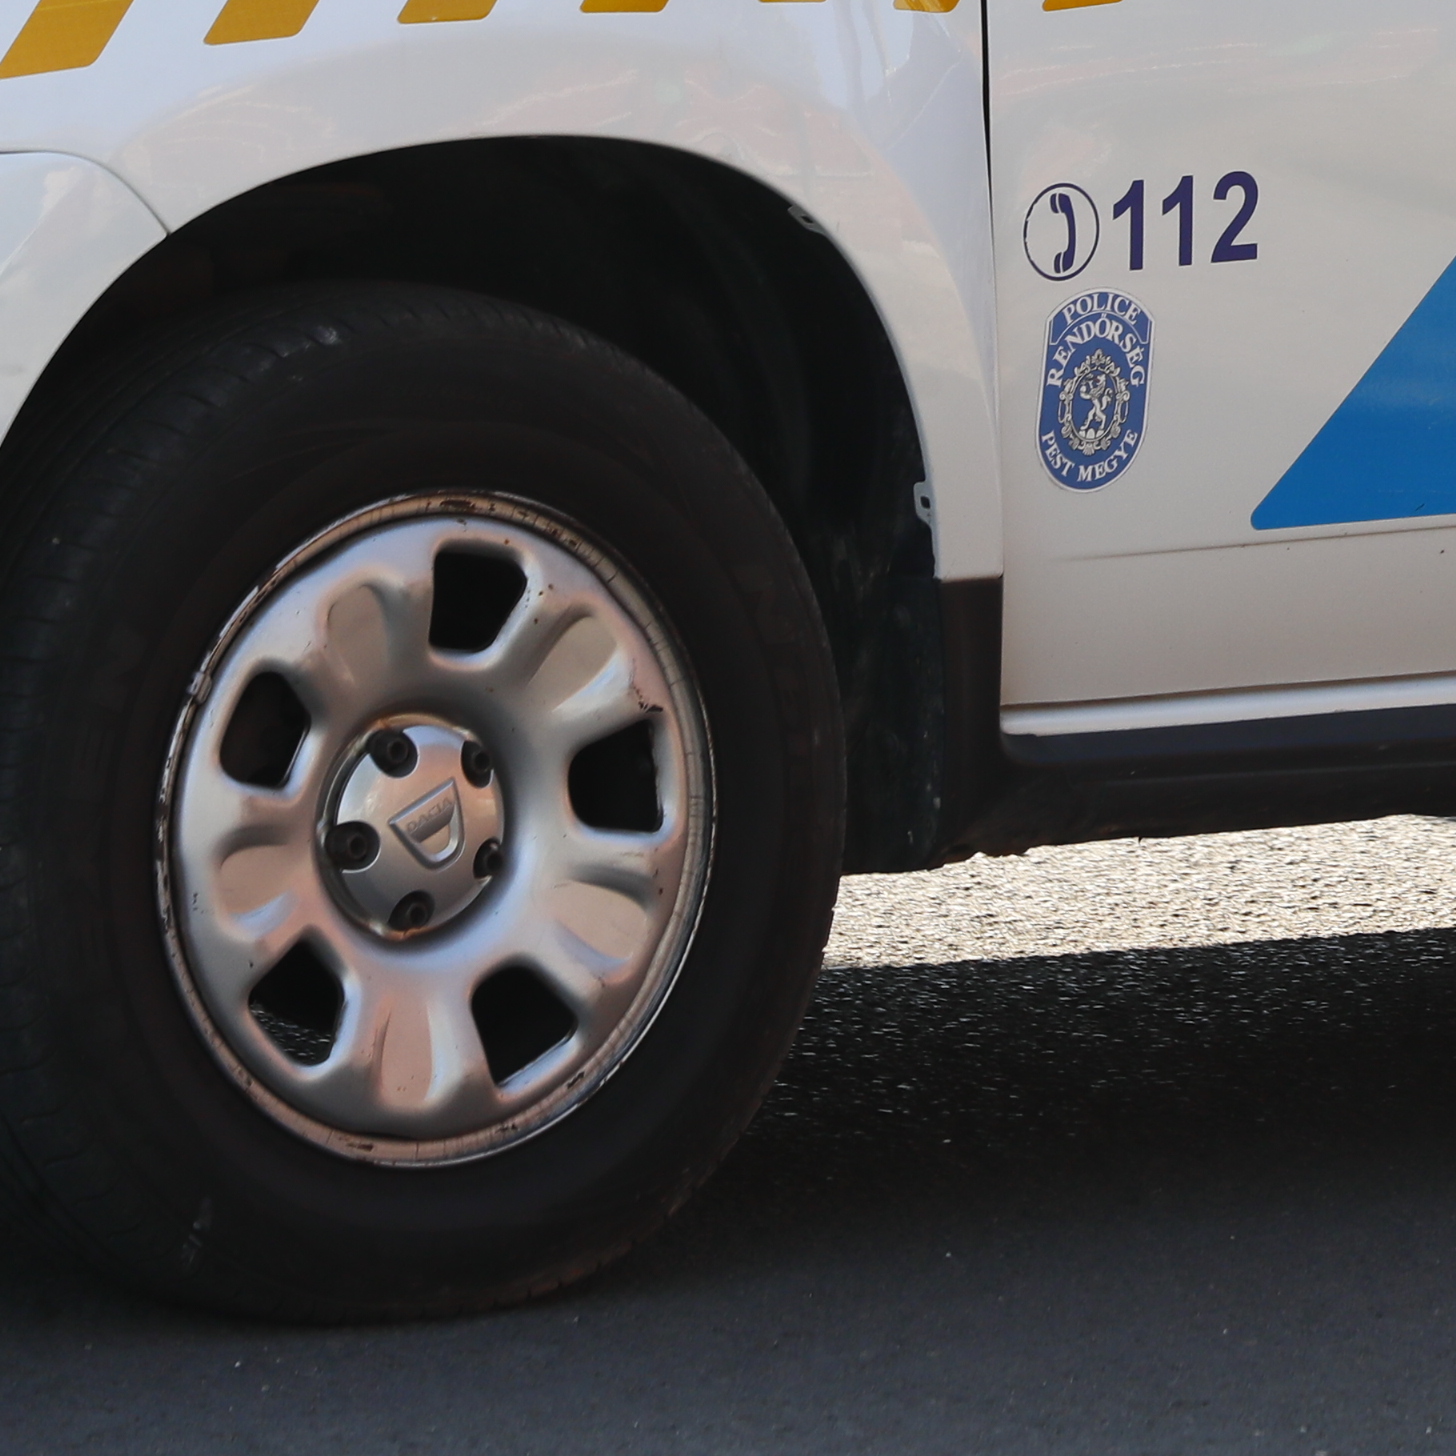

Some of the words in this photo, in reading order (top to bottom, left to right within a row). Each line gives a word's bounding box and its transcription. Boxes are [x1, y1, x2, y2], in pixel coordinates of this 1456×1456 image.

[1112, 170, 1259, 271] 112
[1064, 293, 1141, 325] POLICE
[1046, 313, 1145, 388] RENDŐRSÉG
[1040, 430, 1075, 476] PEST
[1077, 430, 1138, 482] MEGYE
[406, 797, 452, 834] DACIA
